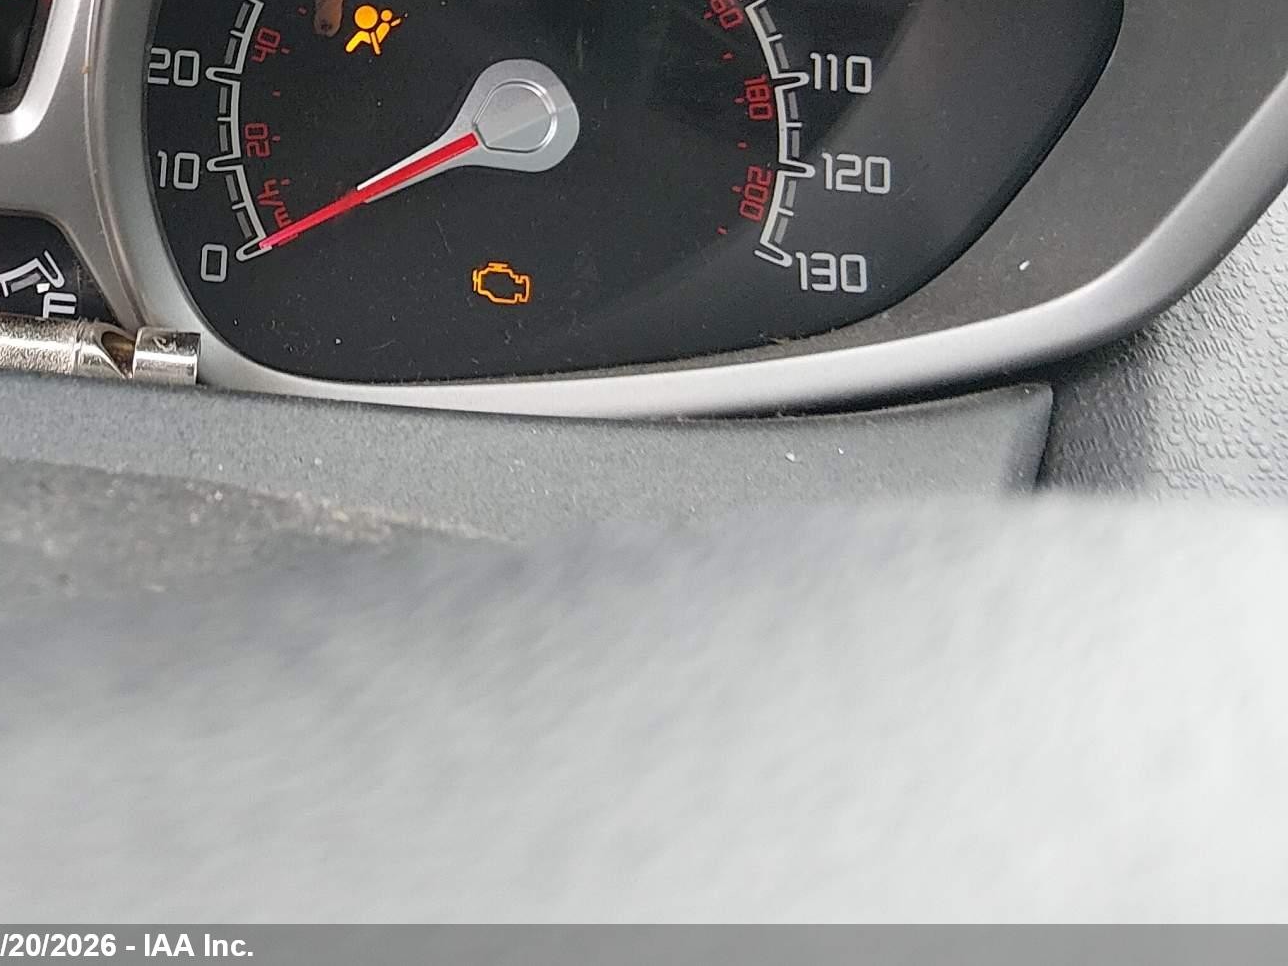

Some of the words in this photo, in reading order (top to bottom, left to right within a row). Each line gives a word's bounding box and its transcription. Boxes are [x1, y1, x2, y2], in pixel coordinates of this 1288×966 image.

[251, 27, 282, 63] 40
[147, 47, 201, 86] 20
[810, 52, 872, 95] 110
[743, 74, 774, 121] 180
[244, 122, 271, 158] 20
[156, 150, 201, 190] 10
[822, 152, 891, 194] 120
[257, 178, 299, 247] m/h
[738, 165, 772, 221] 200
[200, 243, 228, 283] 0
[795, 251, 868, 293] 130
[42, 291, 77, 320] F
